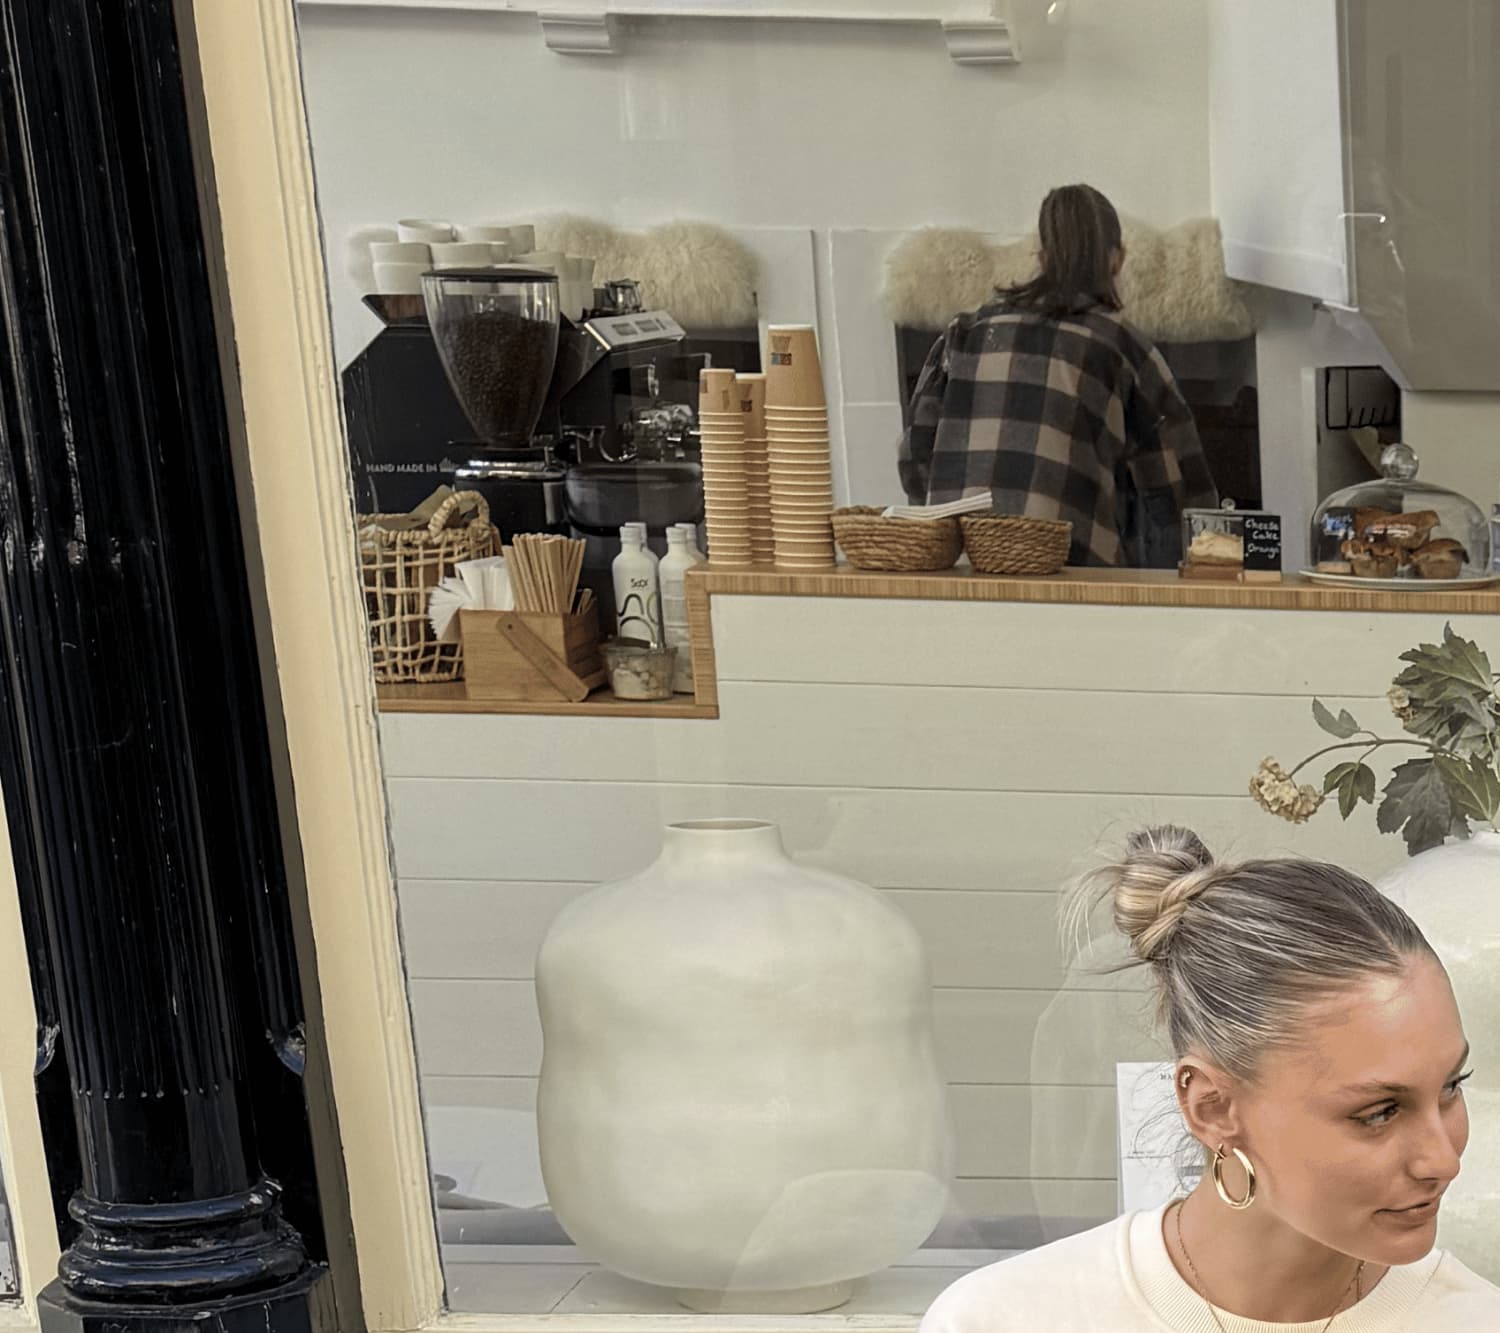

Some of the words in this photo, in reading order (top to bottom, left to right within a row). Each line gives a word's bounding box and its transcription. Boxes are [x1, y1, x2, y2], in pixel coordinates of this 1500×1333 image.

[366, 463, 395, 473] HAND
[397, 463, 425, 473] MADE
[426, 463, 438, 473] IN
